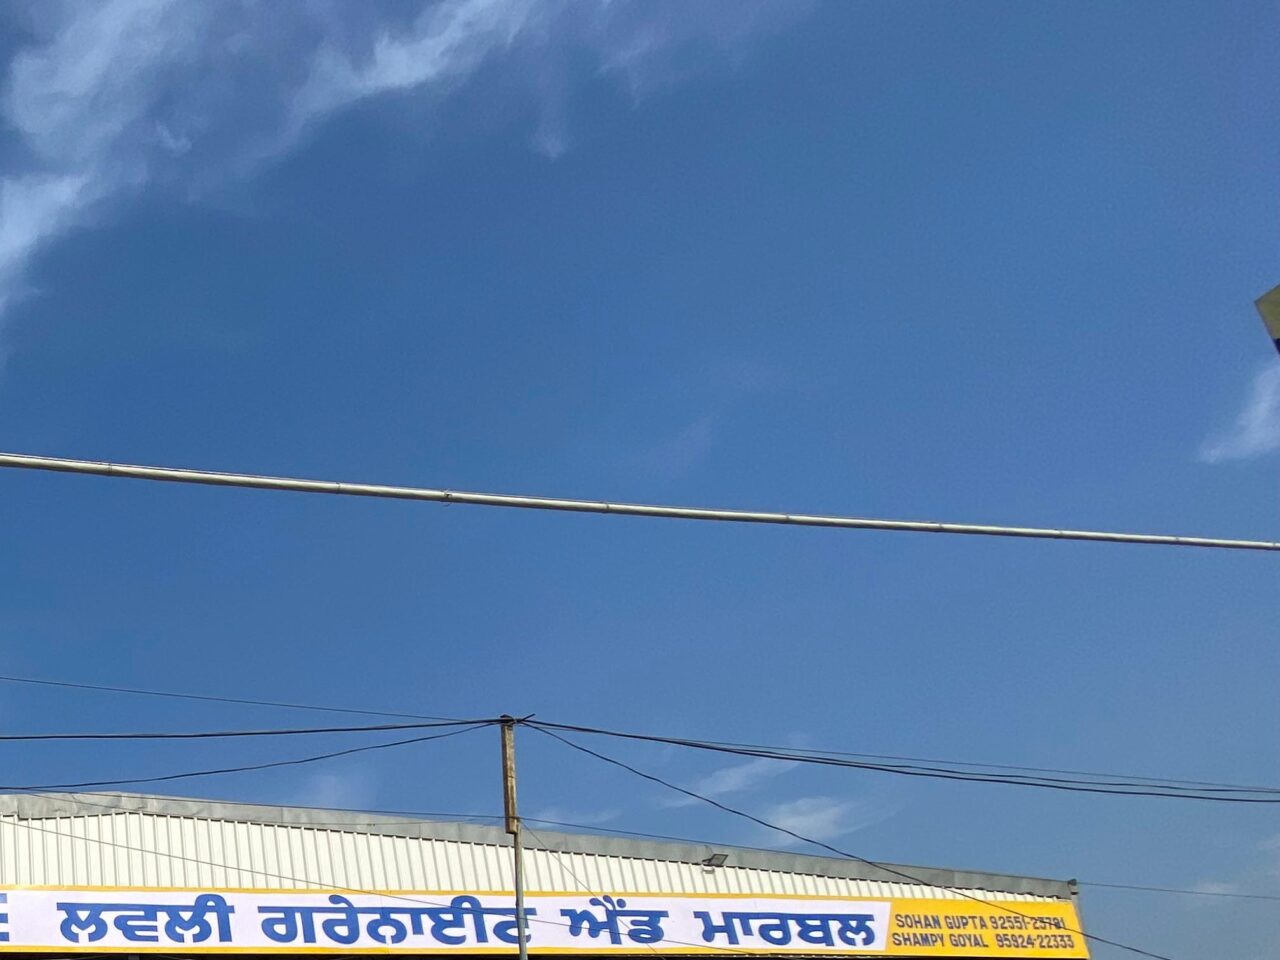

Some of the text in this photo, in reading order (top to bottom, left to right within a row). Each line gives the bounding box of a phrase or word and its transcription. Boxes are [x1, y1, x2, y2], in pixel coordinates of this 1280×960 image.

[56, 893, 235, 944] ਲਵਲੀ
[258, 894, 537, 945] ਗਰੇਨਾਈਟ
[694, 911, 875, 948] ਮਾਰਬਲ
[895, 913, 941, 929] SOHAN
[945, 915, 988, 930] GUPTA
[892, 932, 1075, 949] SHAMPY GOYAL 95924-22333
